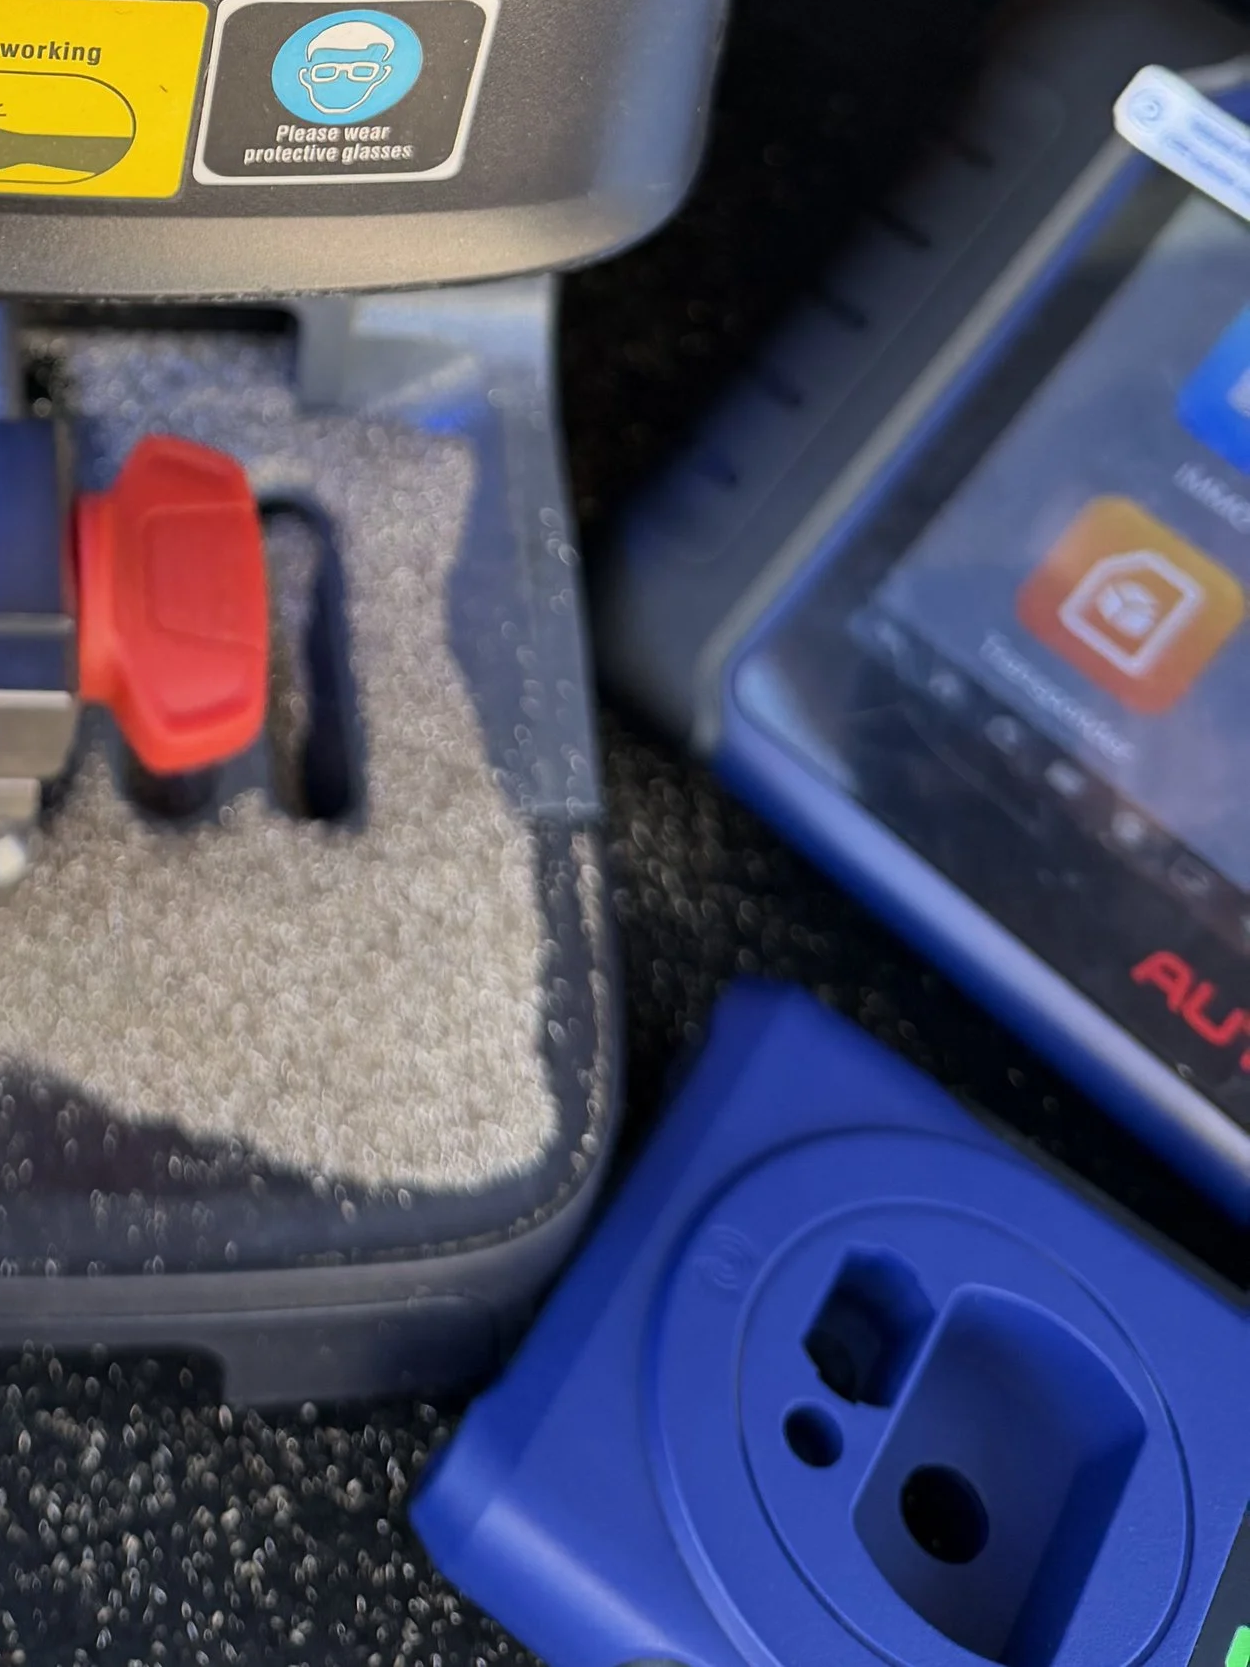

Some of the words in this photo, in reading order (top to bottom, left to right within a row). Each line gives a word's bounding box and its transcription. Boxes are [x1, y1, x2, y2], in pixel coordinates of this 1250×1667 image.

[0, 40, 102, 65] working
[276, 125, 340, 142] Please
[344, 126, 391, 142] wear
[244, 144, 339, 165] protective
[341, 143, 413, 165] glasses
[1130, 950, 1250, 1075] AU
